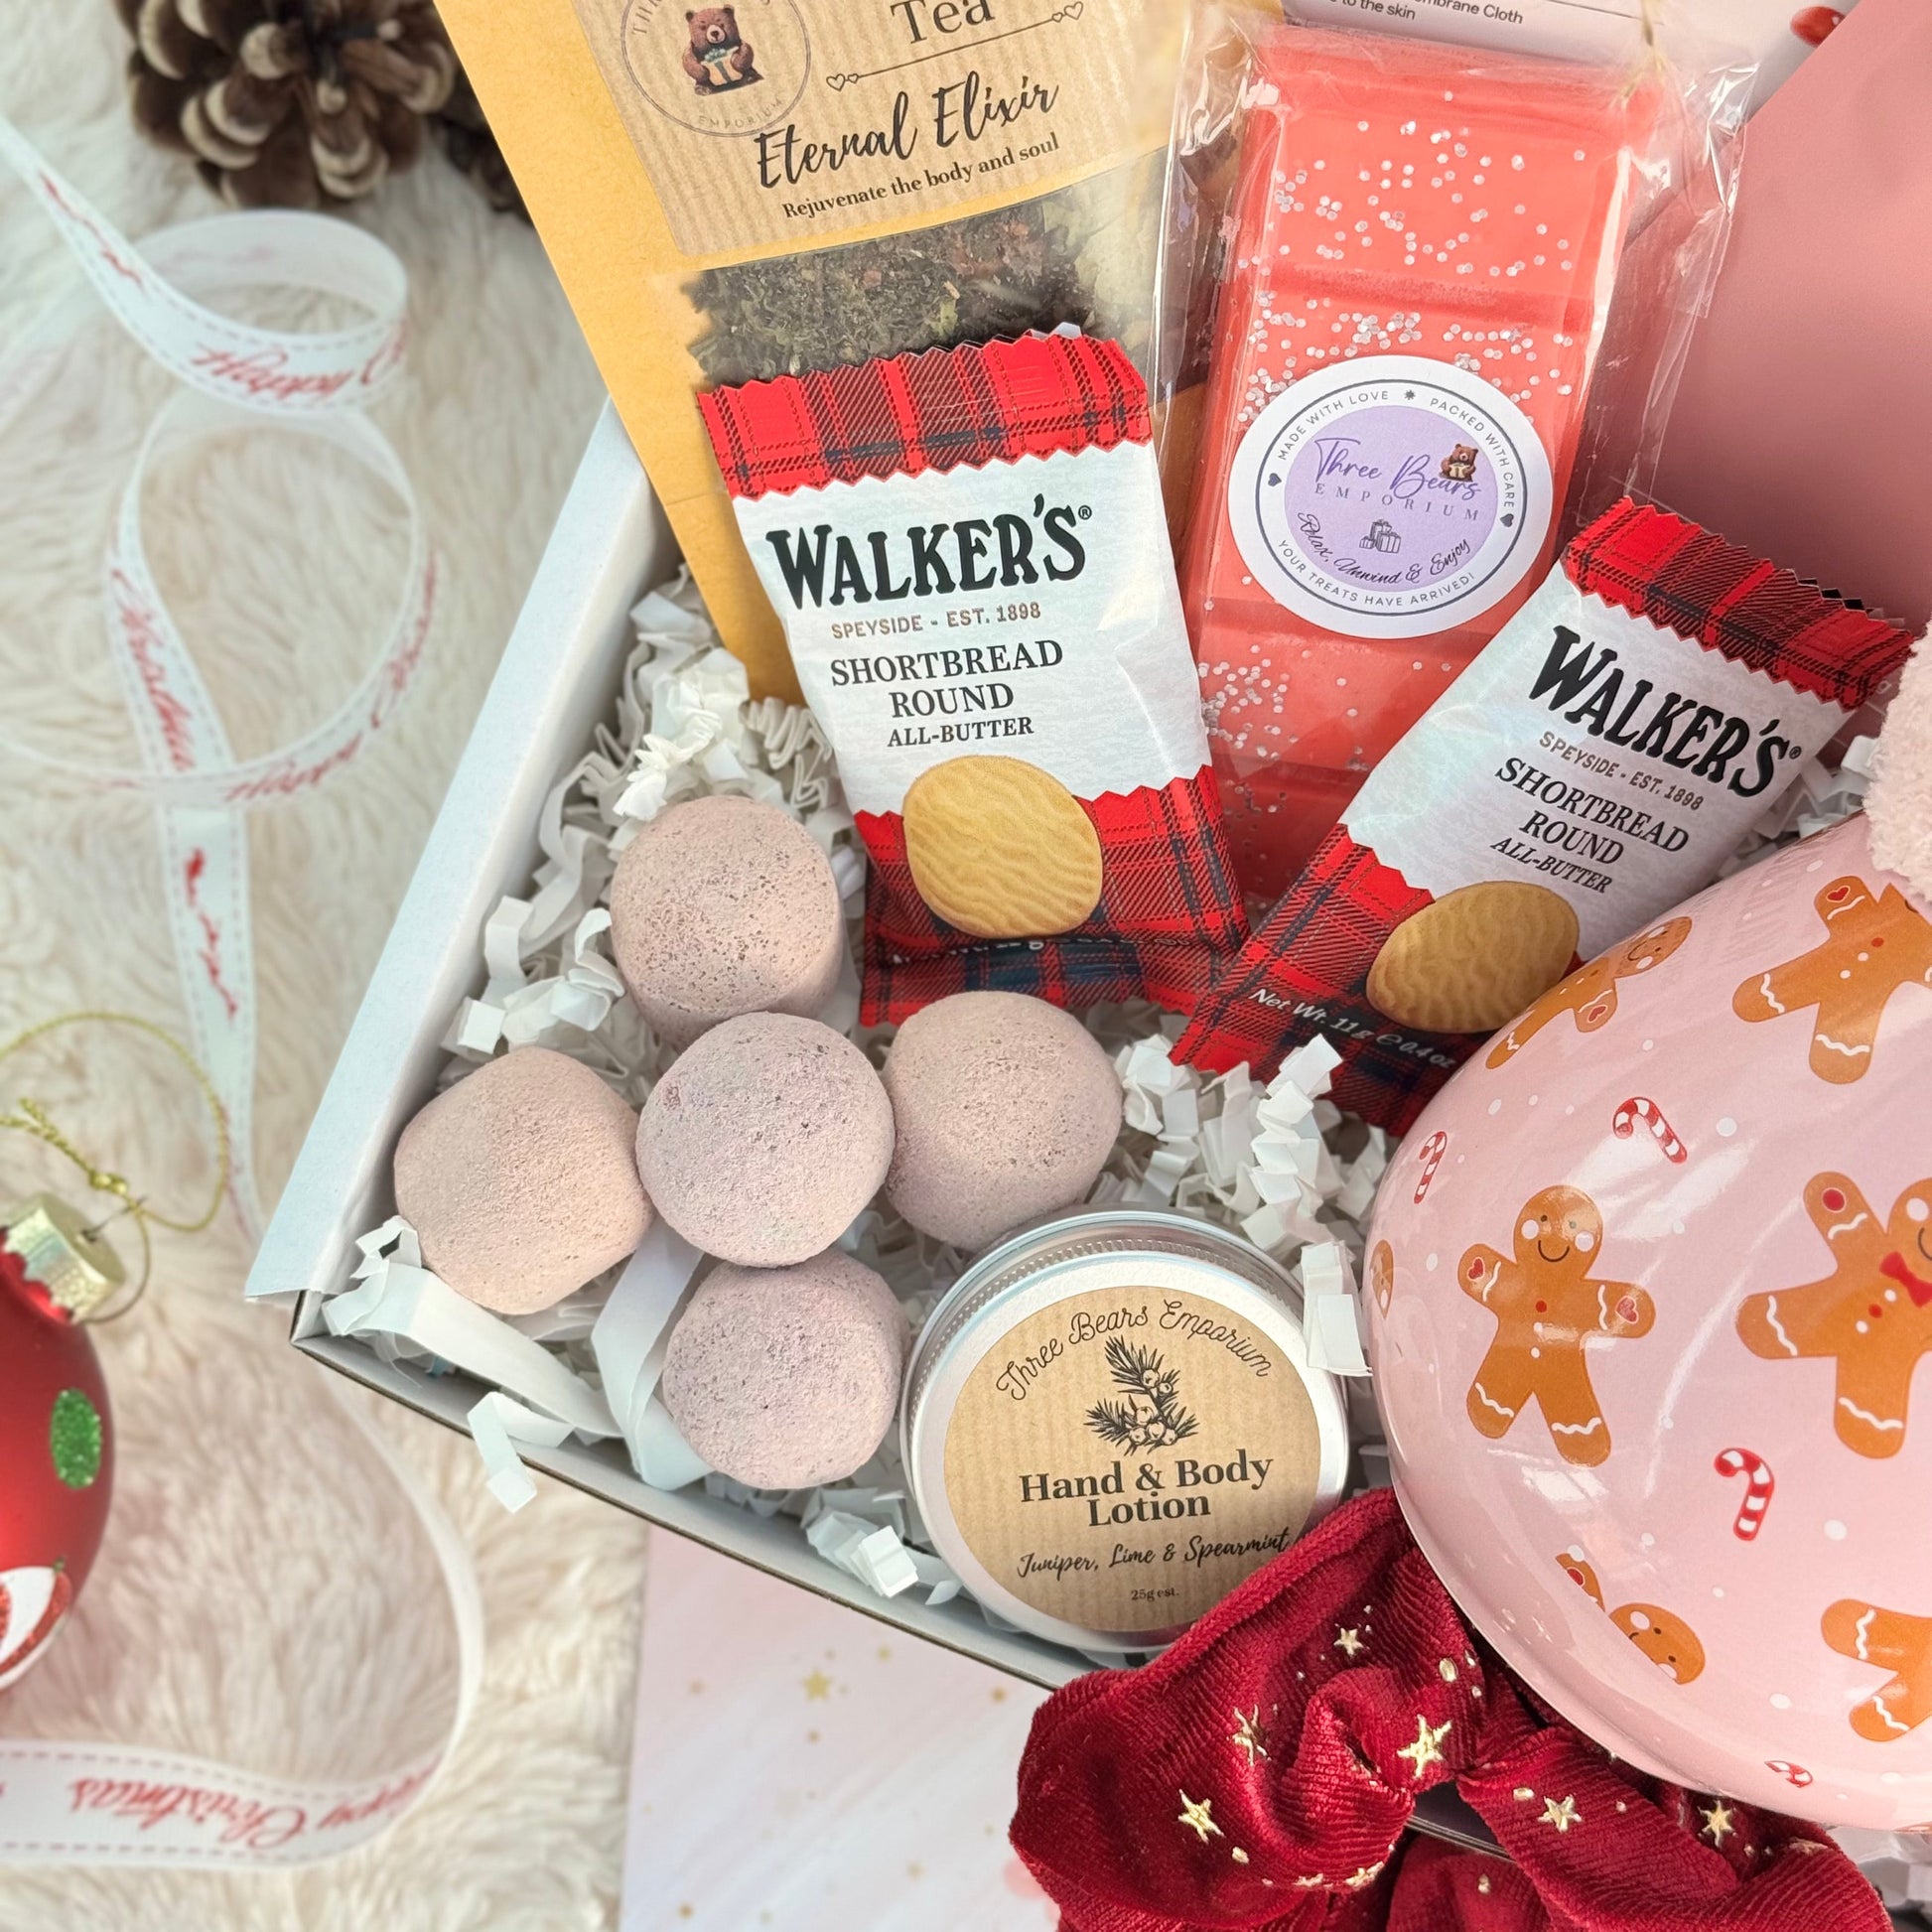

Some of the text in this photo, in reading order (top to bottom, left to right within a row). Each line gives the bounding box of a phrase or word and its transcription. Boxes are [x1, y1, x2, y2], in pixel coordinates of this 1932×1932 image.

[890, 0, 995, 44] Tea
[1360, 0, 1384, 12] the
[1386, 3, 1416, 20] skin
[1483, 4, 1524, 24] Cloth
[698, 98, 783, 130] EMPORIUM
[754, 70, 1060, 189] Eternal Elixir
[782, 132, 1059, 218] Rejuvenate the body and soul
[1278, 390, 1389, 461] MADE WITH LOVE
[1430, 397, 1515, 508] PACKED WITH CARE
[1314, 437, 1481, 500] Three Bears
[1314, 483, 1479, 521] EMPORIUM
[1278, 539, 1307, 575] YOUR
[1309, 572, 1358, 603] TREATS
[1364, 595, 1403, 608] HAVE
[1297, 511, 1470, 585] Relax, Unwind & Enjoy
[831, 615, 923, 639] SPEYSIDE
[946, 608, 991, 628] EST.
[996, 601, 1041, 622] 1898
[830, 638, 1063, 687] SHORTBREAD
[889, 682, 1015, 718] ROUND
[887, 716, 1035, 747] ALL-BUTTER
[1539, 731, 1620, 778] SPEYSIDE
[1628, 770, 1662, 795] EST.
[1664, 784, 1705, 811] 1898
[1494, 757, 1690, 853] SHORTBREAD
[1490, 837, 1613, 894] ALL-BUTTER
[1519, 810, 1624, 866] ROUND
[1248, 988, 1291, 1011] Net
[1293, 1001, 1327, 1024] Wt.
[1329, 1018, 1359, 1033] 11
[1399, 1041, 1435, 1057] 0.4
[996, 1299, 1273, 1401] Three Bears Emporium
[1020, 1449, 1274, 1502] Hand & Body
[1087, 1491, 1211, 1527] Lotion
[1017, 1526, 1290, 1582] Juniper, Lime & Spearmint
[1131, 1589, 1156, 1602] 25g
